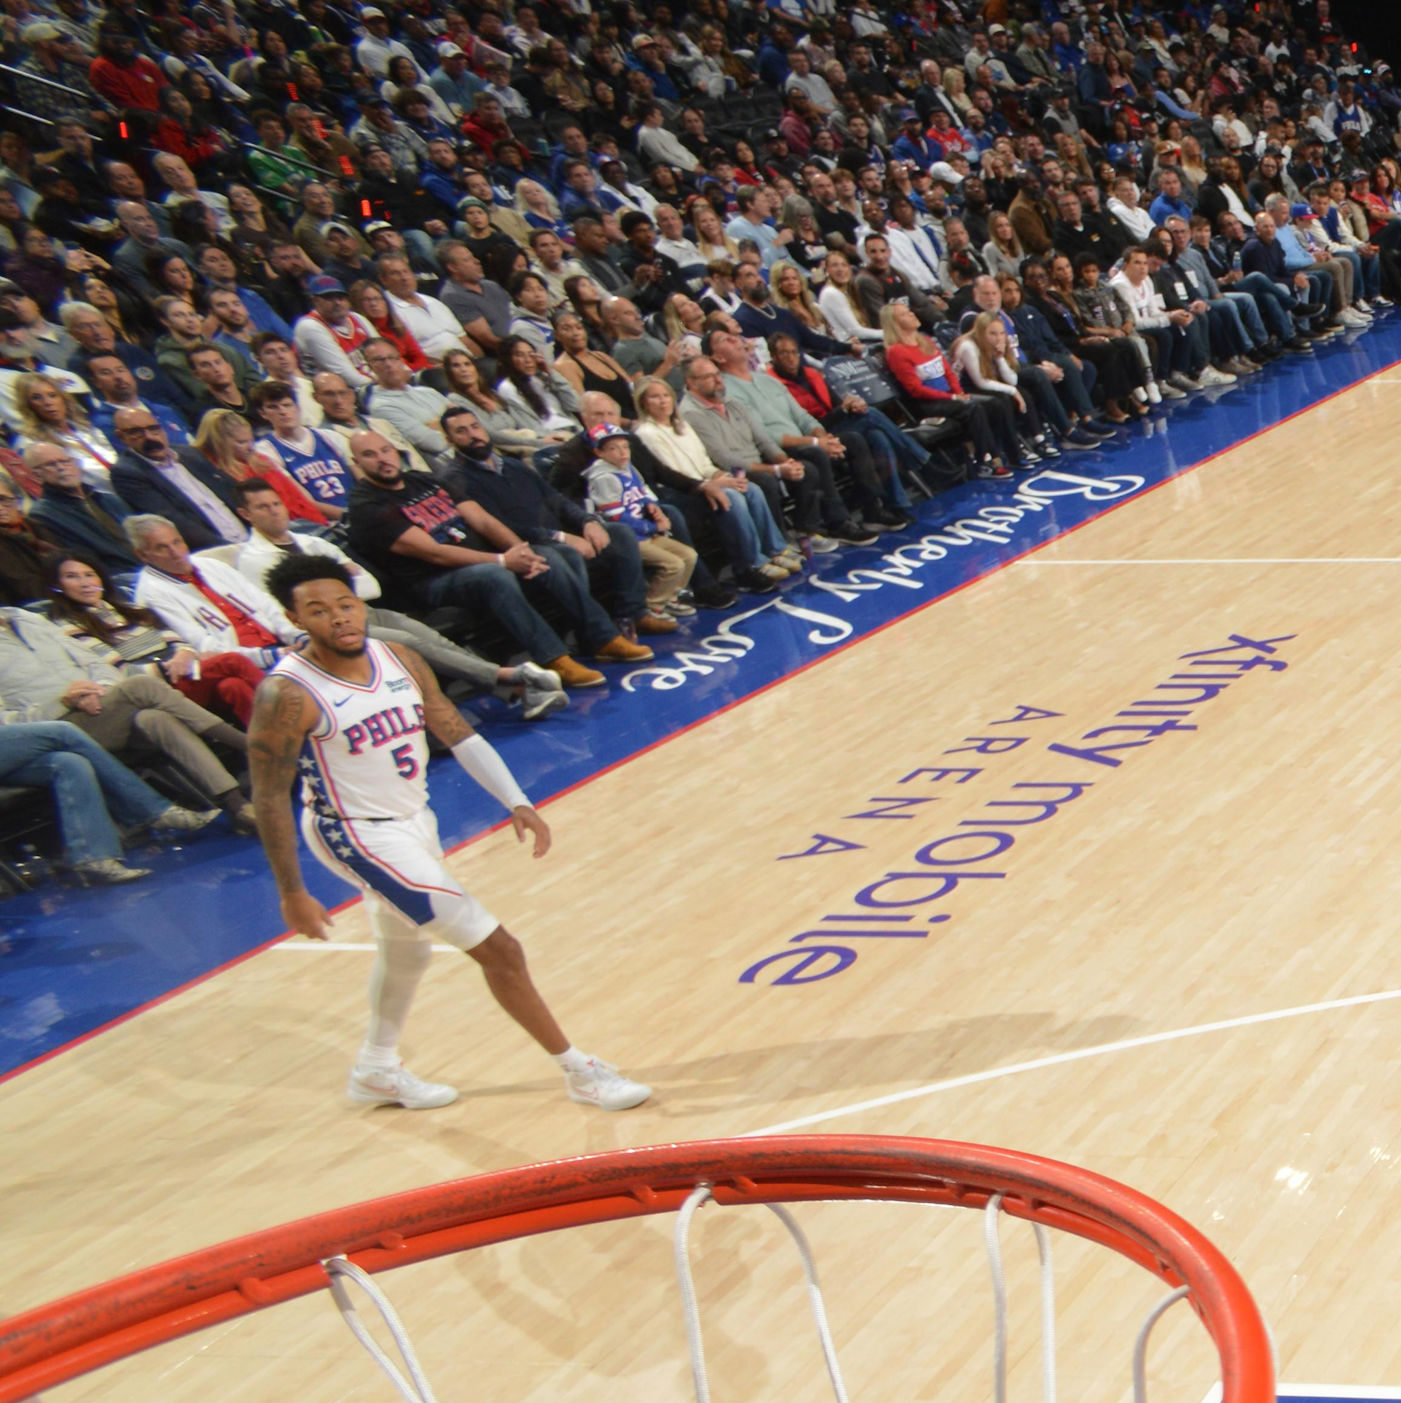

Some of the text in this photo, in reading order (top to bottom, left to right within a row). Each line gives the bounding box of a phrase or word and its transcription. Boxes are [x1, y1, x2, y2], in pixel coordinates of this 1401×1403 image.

[314, 477, 346, 499] 23
[620, 470, 1146, 693] Brotherly Love
[390, 743, 420, 781] 5
[737, 633, 1299, 986] xfinity mobile
[775, 703, 1068, 862] ARENA
